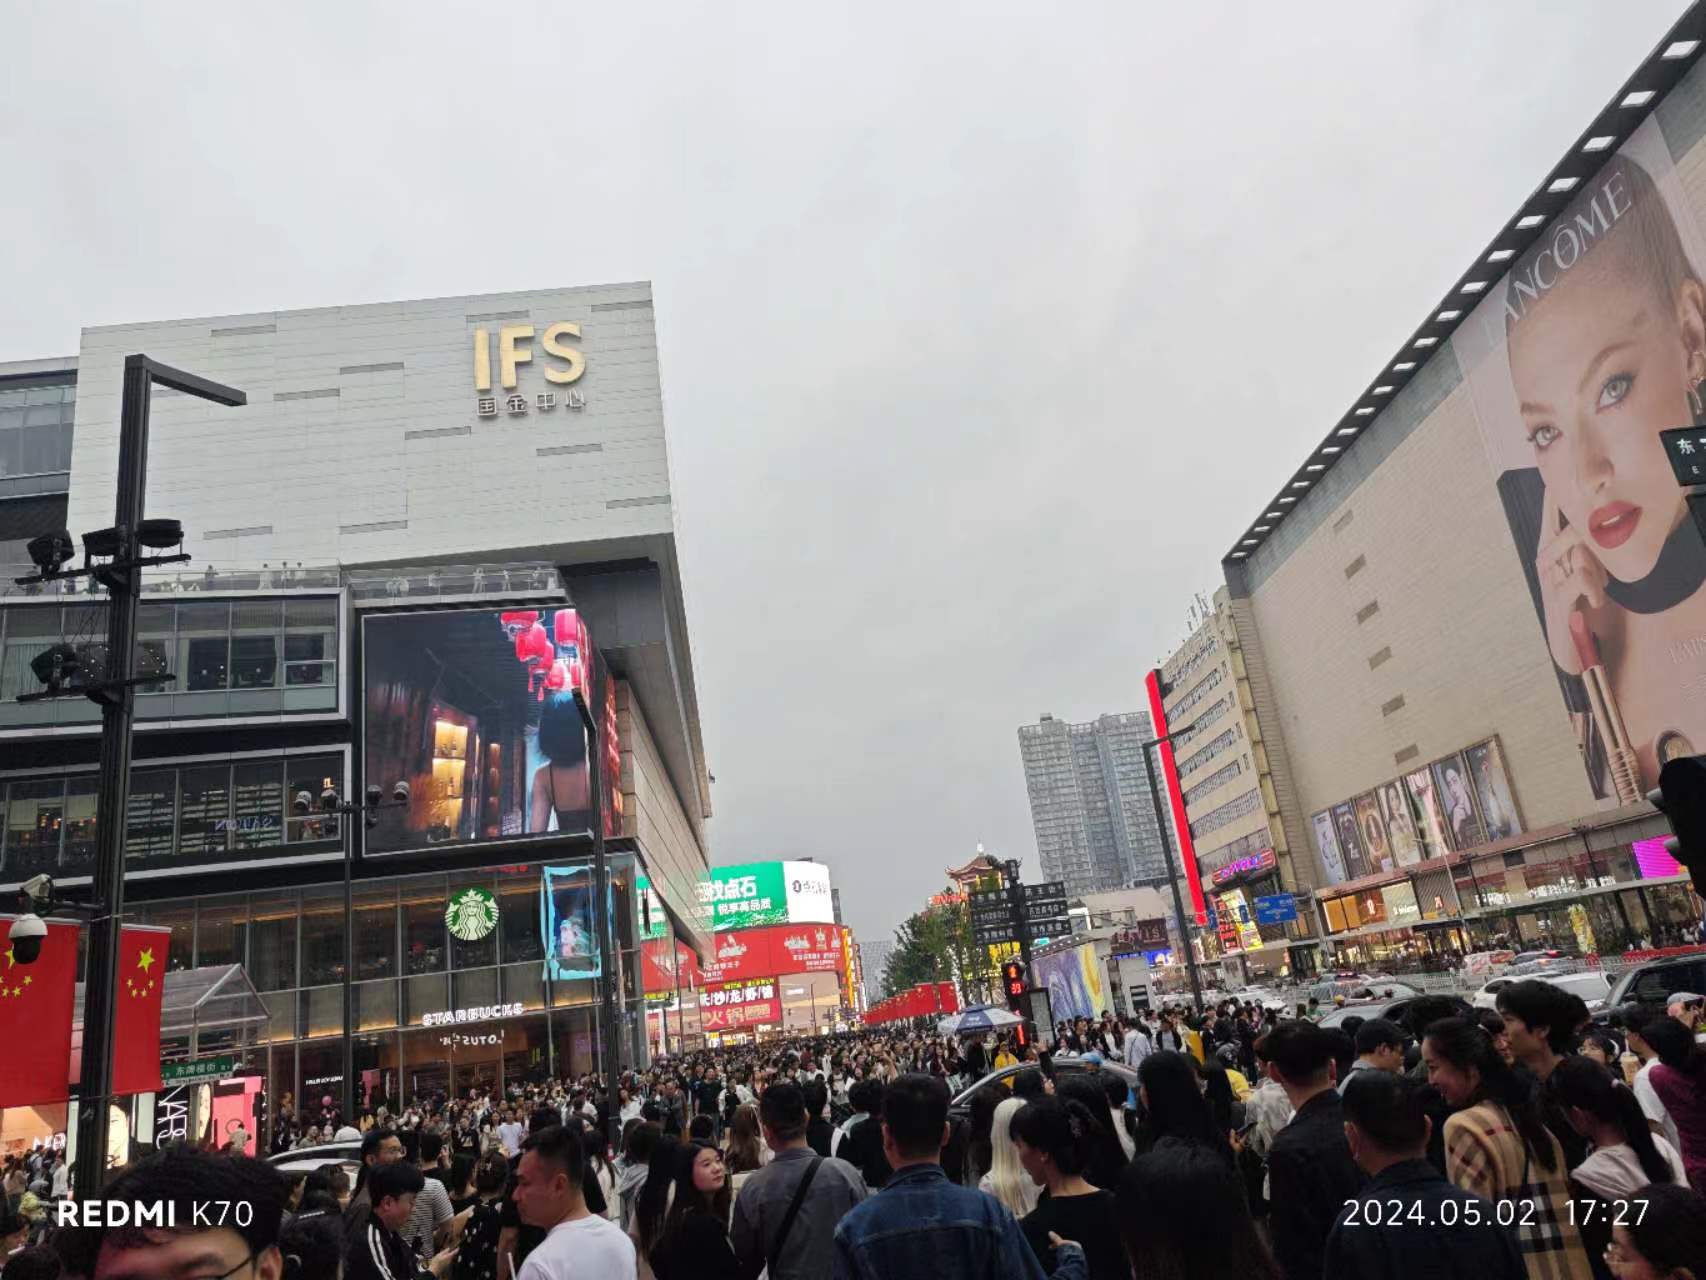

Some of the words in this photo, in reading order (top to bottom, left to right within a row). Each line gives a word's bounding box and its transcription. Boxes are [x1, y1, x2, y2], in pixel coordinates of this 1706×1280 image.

[474, 321, 586, 390] IFS
[477, 389, 586, 417] 国金中心
[422, 1003, 524, 1026] STARBUCKS
